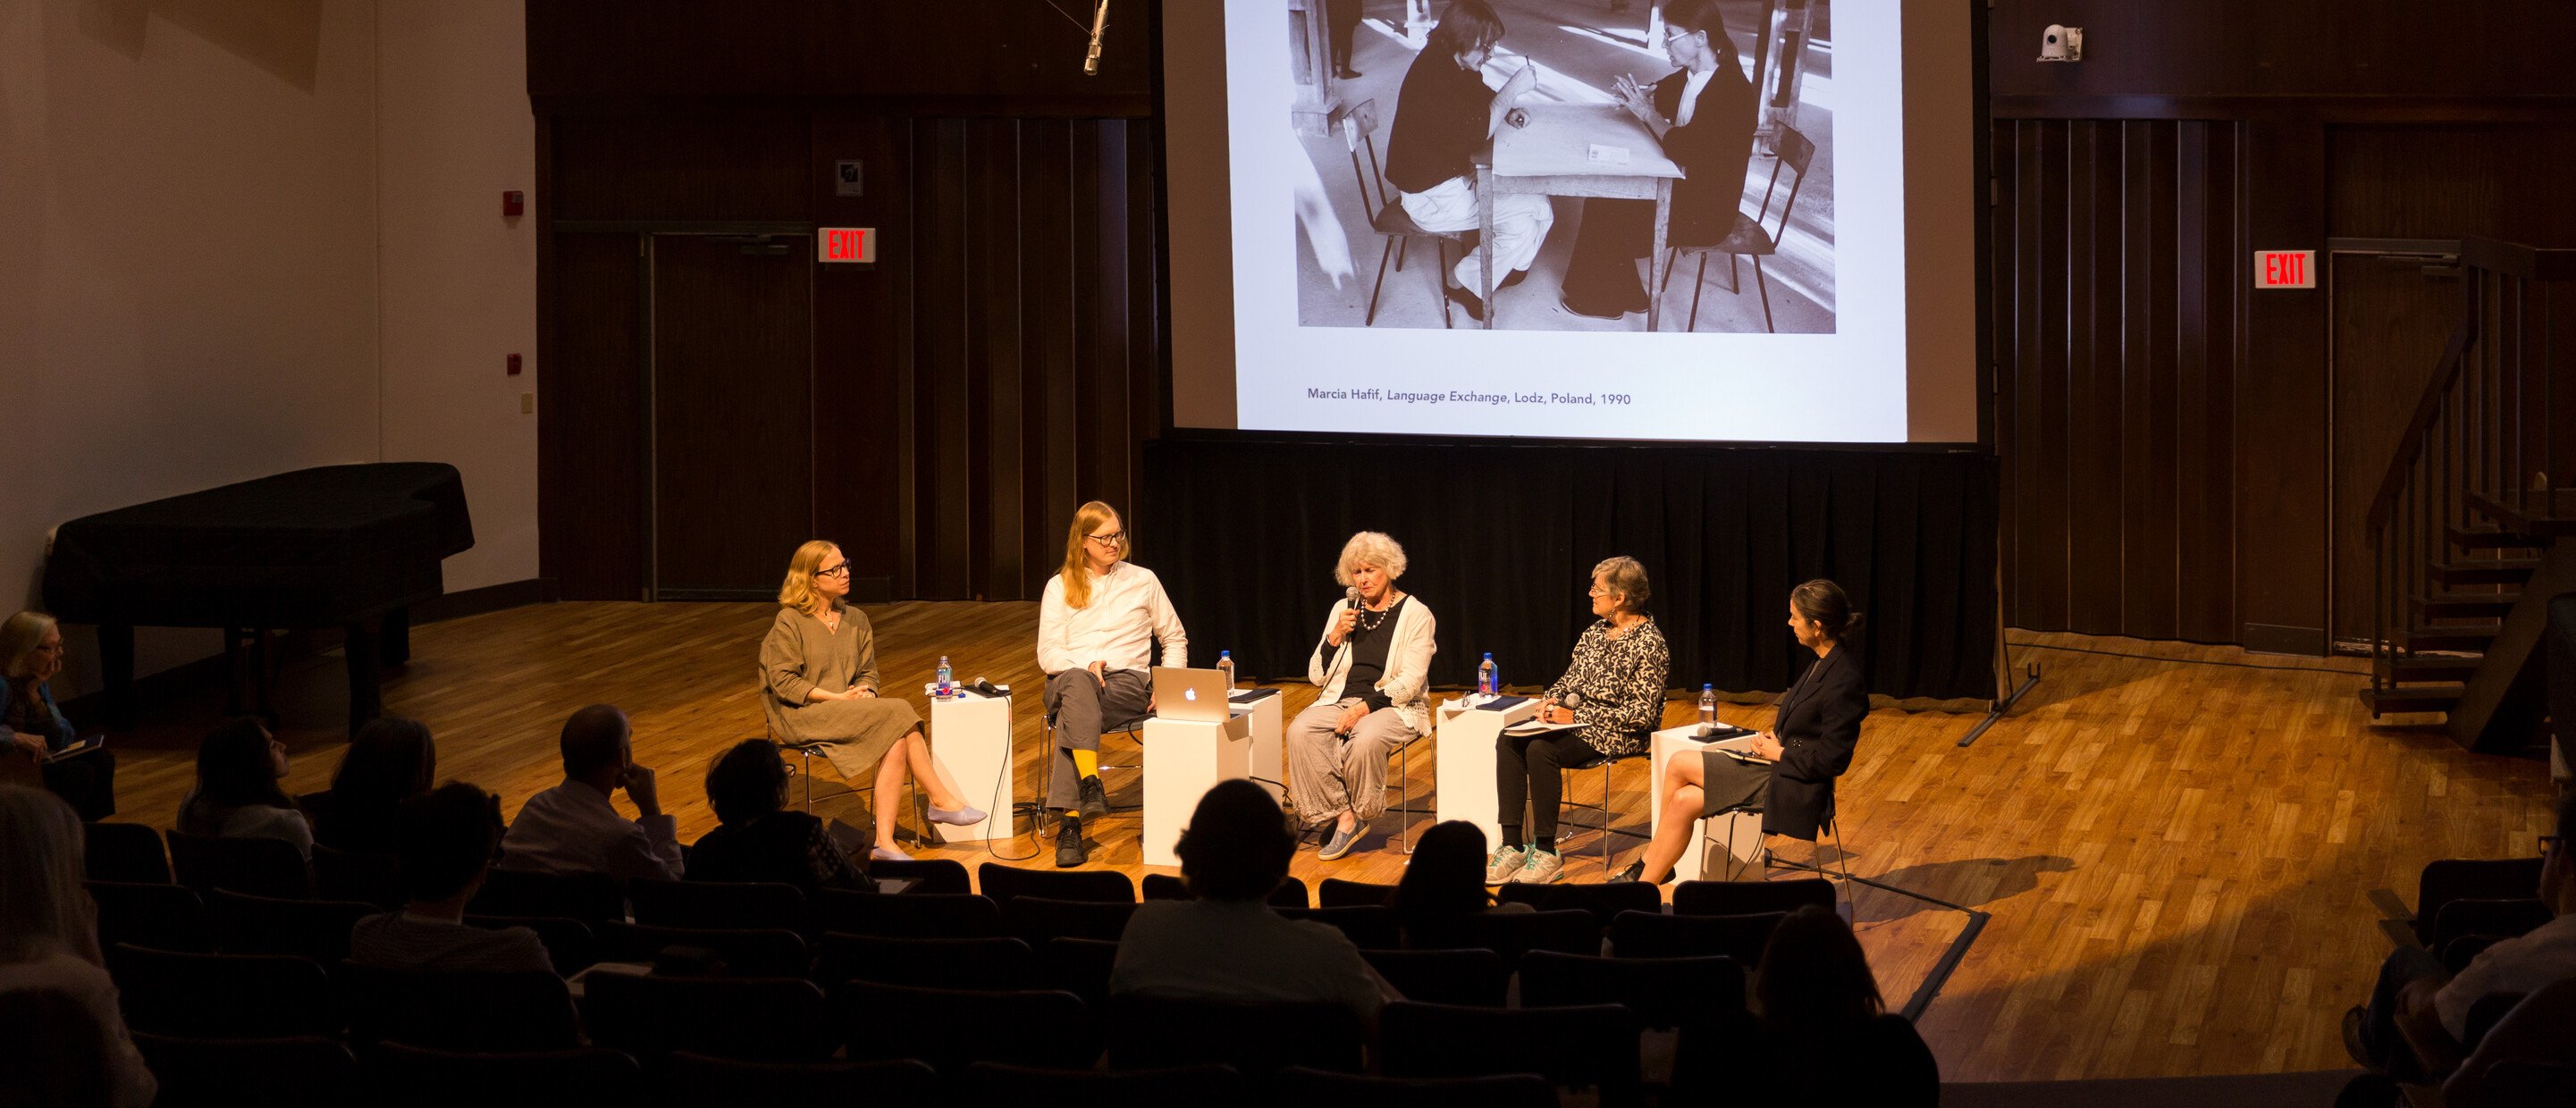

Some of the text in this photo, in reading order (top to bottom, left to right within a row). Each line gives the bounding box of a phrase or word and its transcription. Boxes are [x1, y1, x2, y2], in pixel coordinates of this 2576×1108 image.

[829, 230, 865, 259] EXIT
[2266, 253, 2306, 285] EXIT
[1307, 387, 1631, 406] Marcia Hafif, Language Exchange, Lodz, Poland, 1990
[938, 675, 950, 684] FIJI
